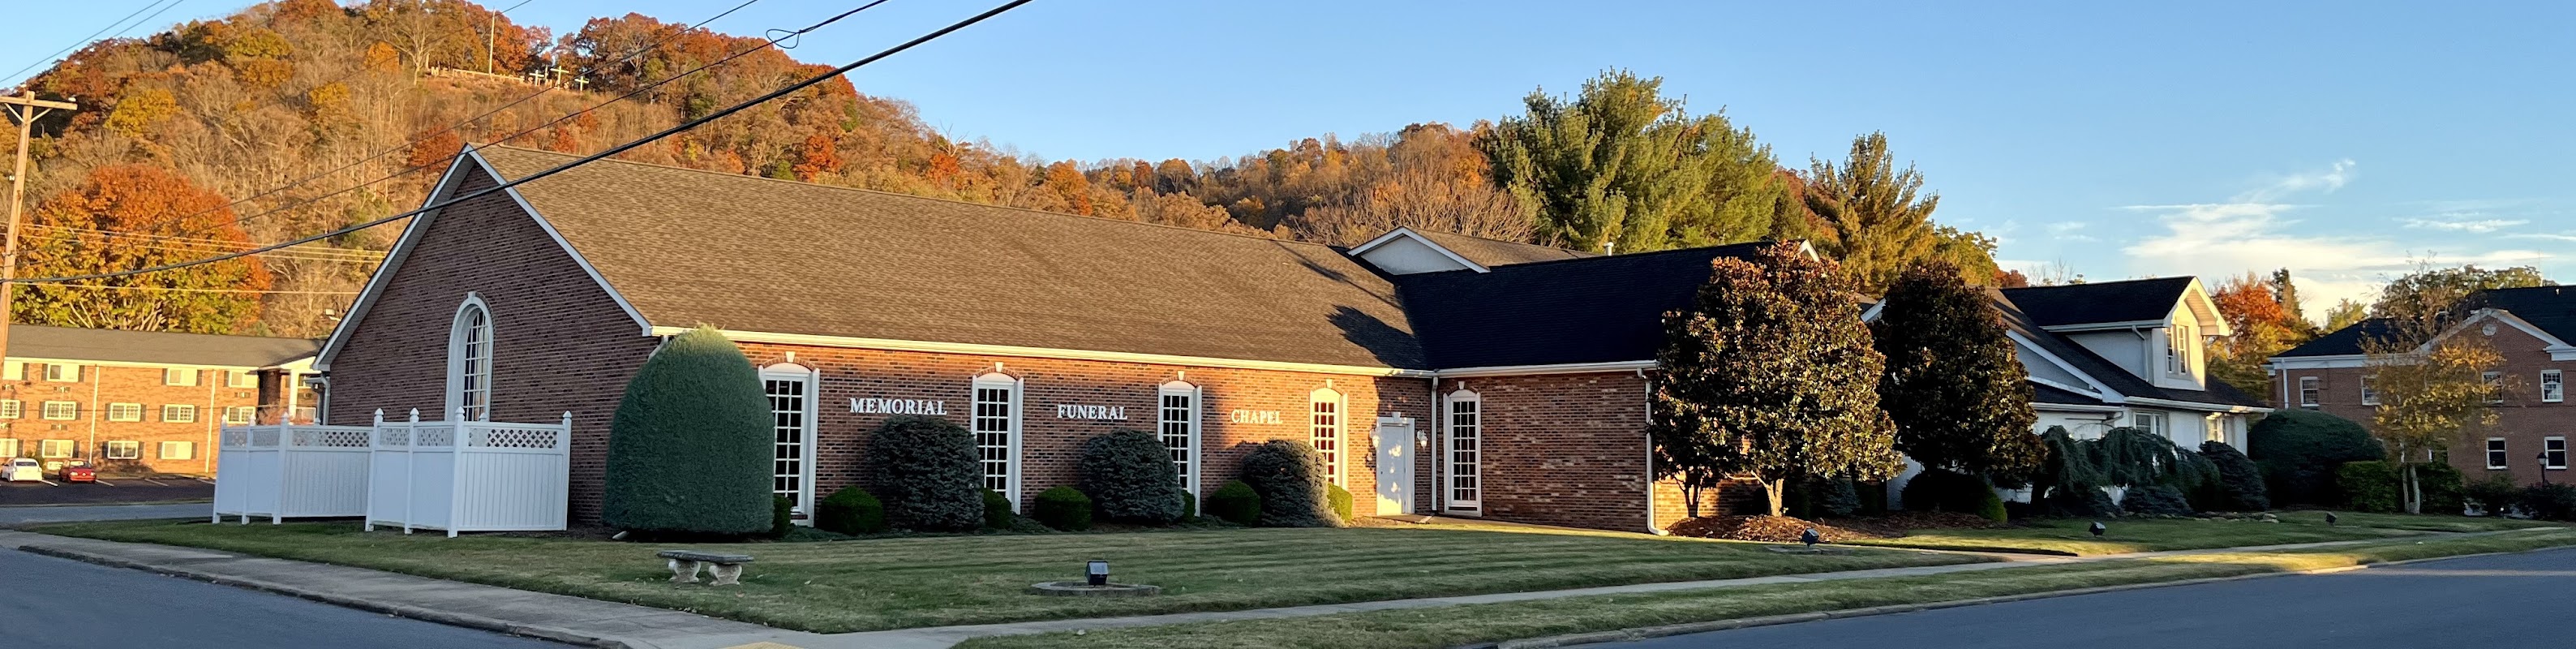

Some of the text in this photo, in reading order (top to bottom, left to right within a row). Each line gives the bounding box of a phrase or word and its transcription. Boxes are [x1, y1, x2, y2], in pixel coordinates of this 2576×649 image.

[849, 398, 1283, 424] MEMORIAL FUNERAL CHAPEL
